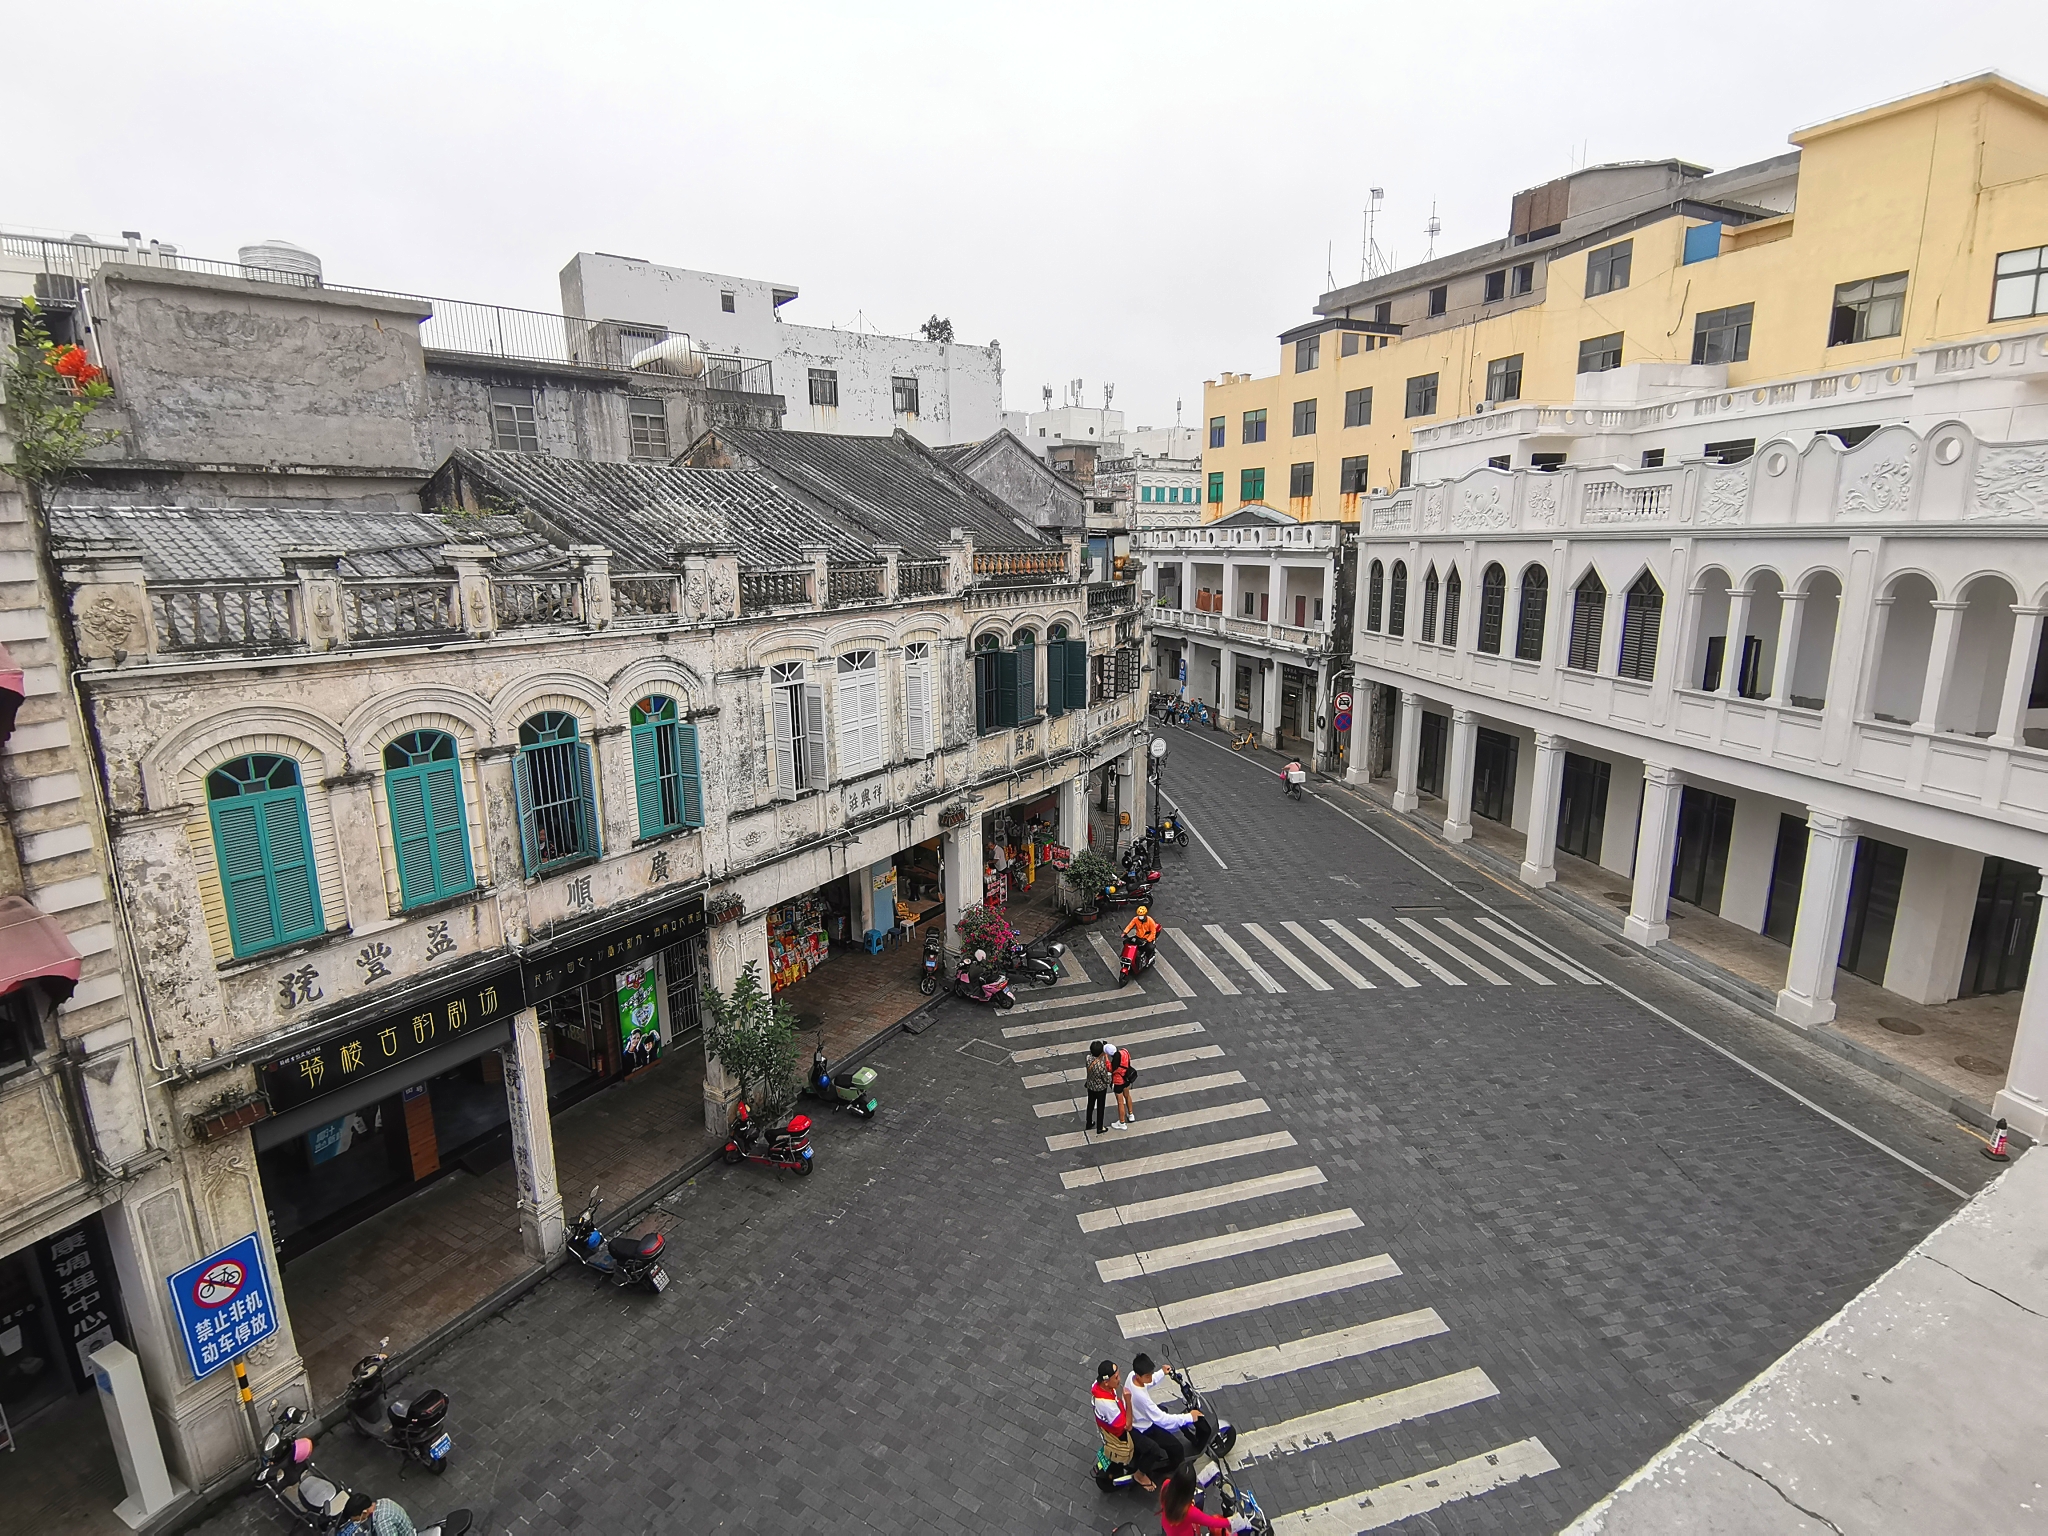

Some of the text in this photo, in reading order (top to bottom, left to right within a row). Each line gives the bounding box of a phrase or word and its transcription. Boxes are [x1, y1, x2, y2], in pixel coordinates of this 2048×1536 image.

[299, 986, 499, 1089] 骑楼古韵剧场
[50, 1222, 109, 1338] 康调理中心
[195, 1290, 263, 1344] 禁止非机
[201, 1312, 268, 1364] 动车停放
